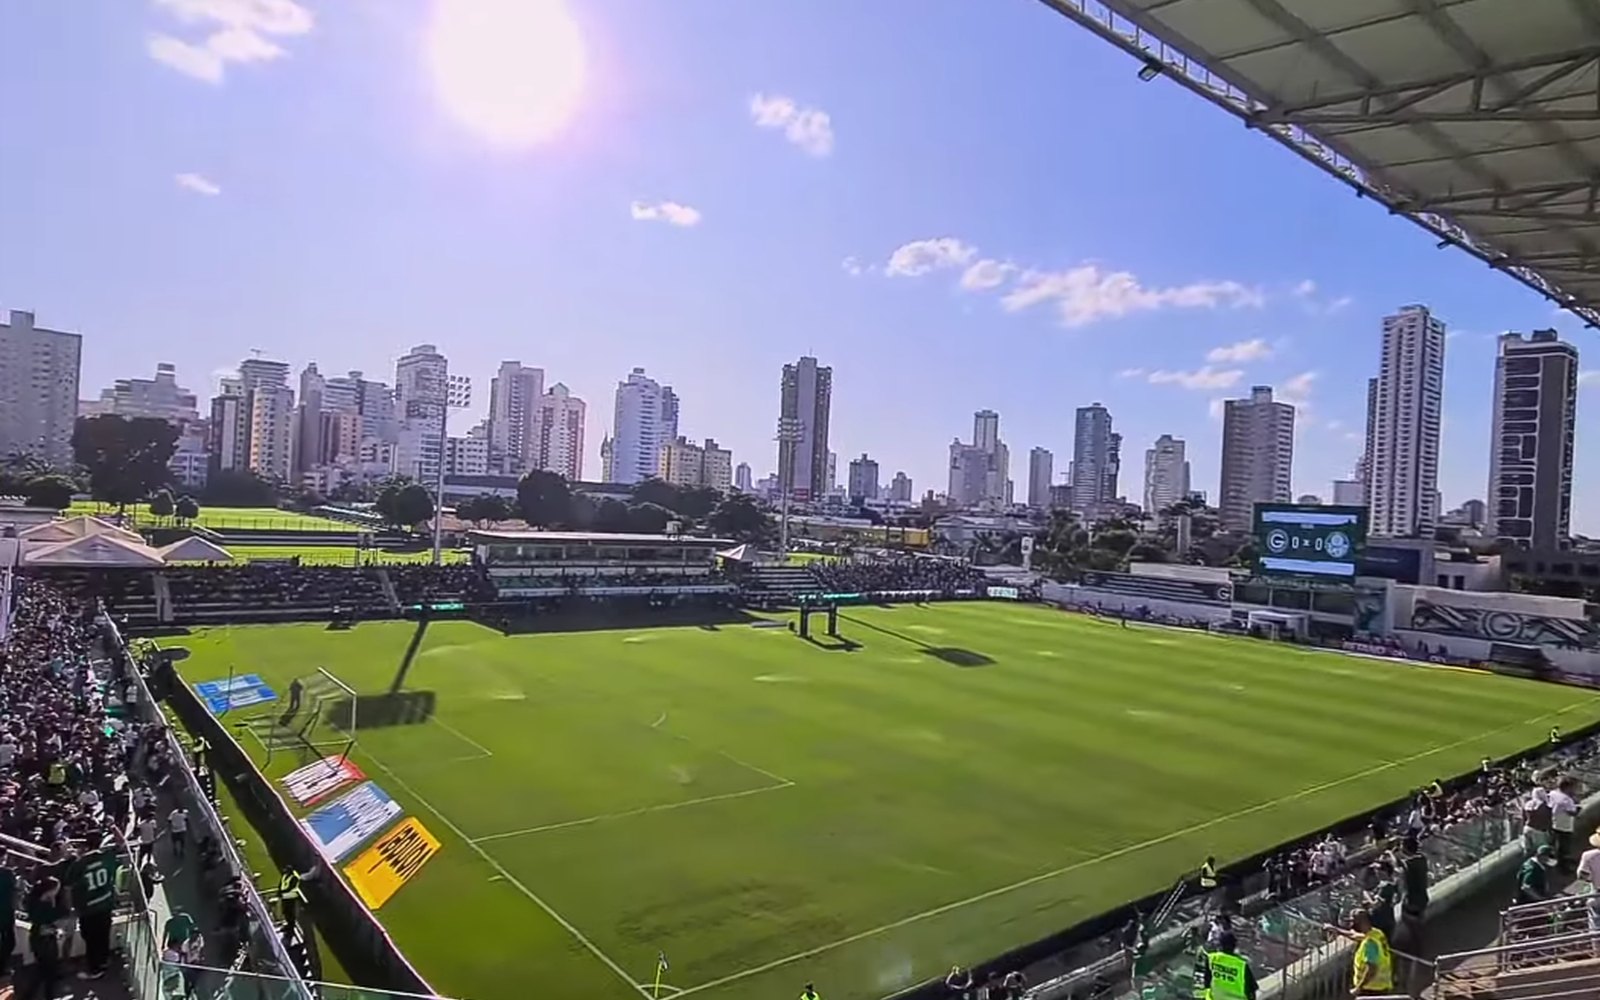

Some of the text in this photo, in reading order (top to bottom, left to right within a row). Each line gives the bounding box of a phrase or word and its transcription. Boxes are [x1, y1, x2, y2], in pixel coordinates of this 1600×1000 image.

[1291, 536, 1299, 549] 0
[1315, 538, 1323, 551] 0
[84, 868, 108, 890] 10
